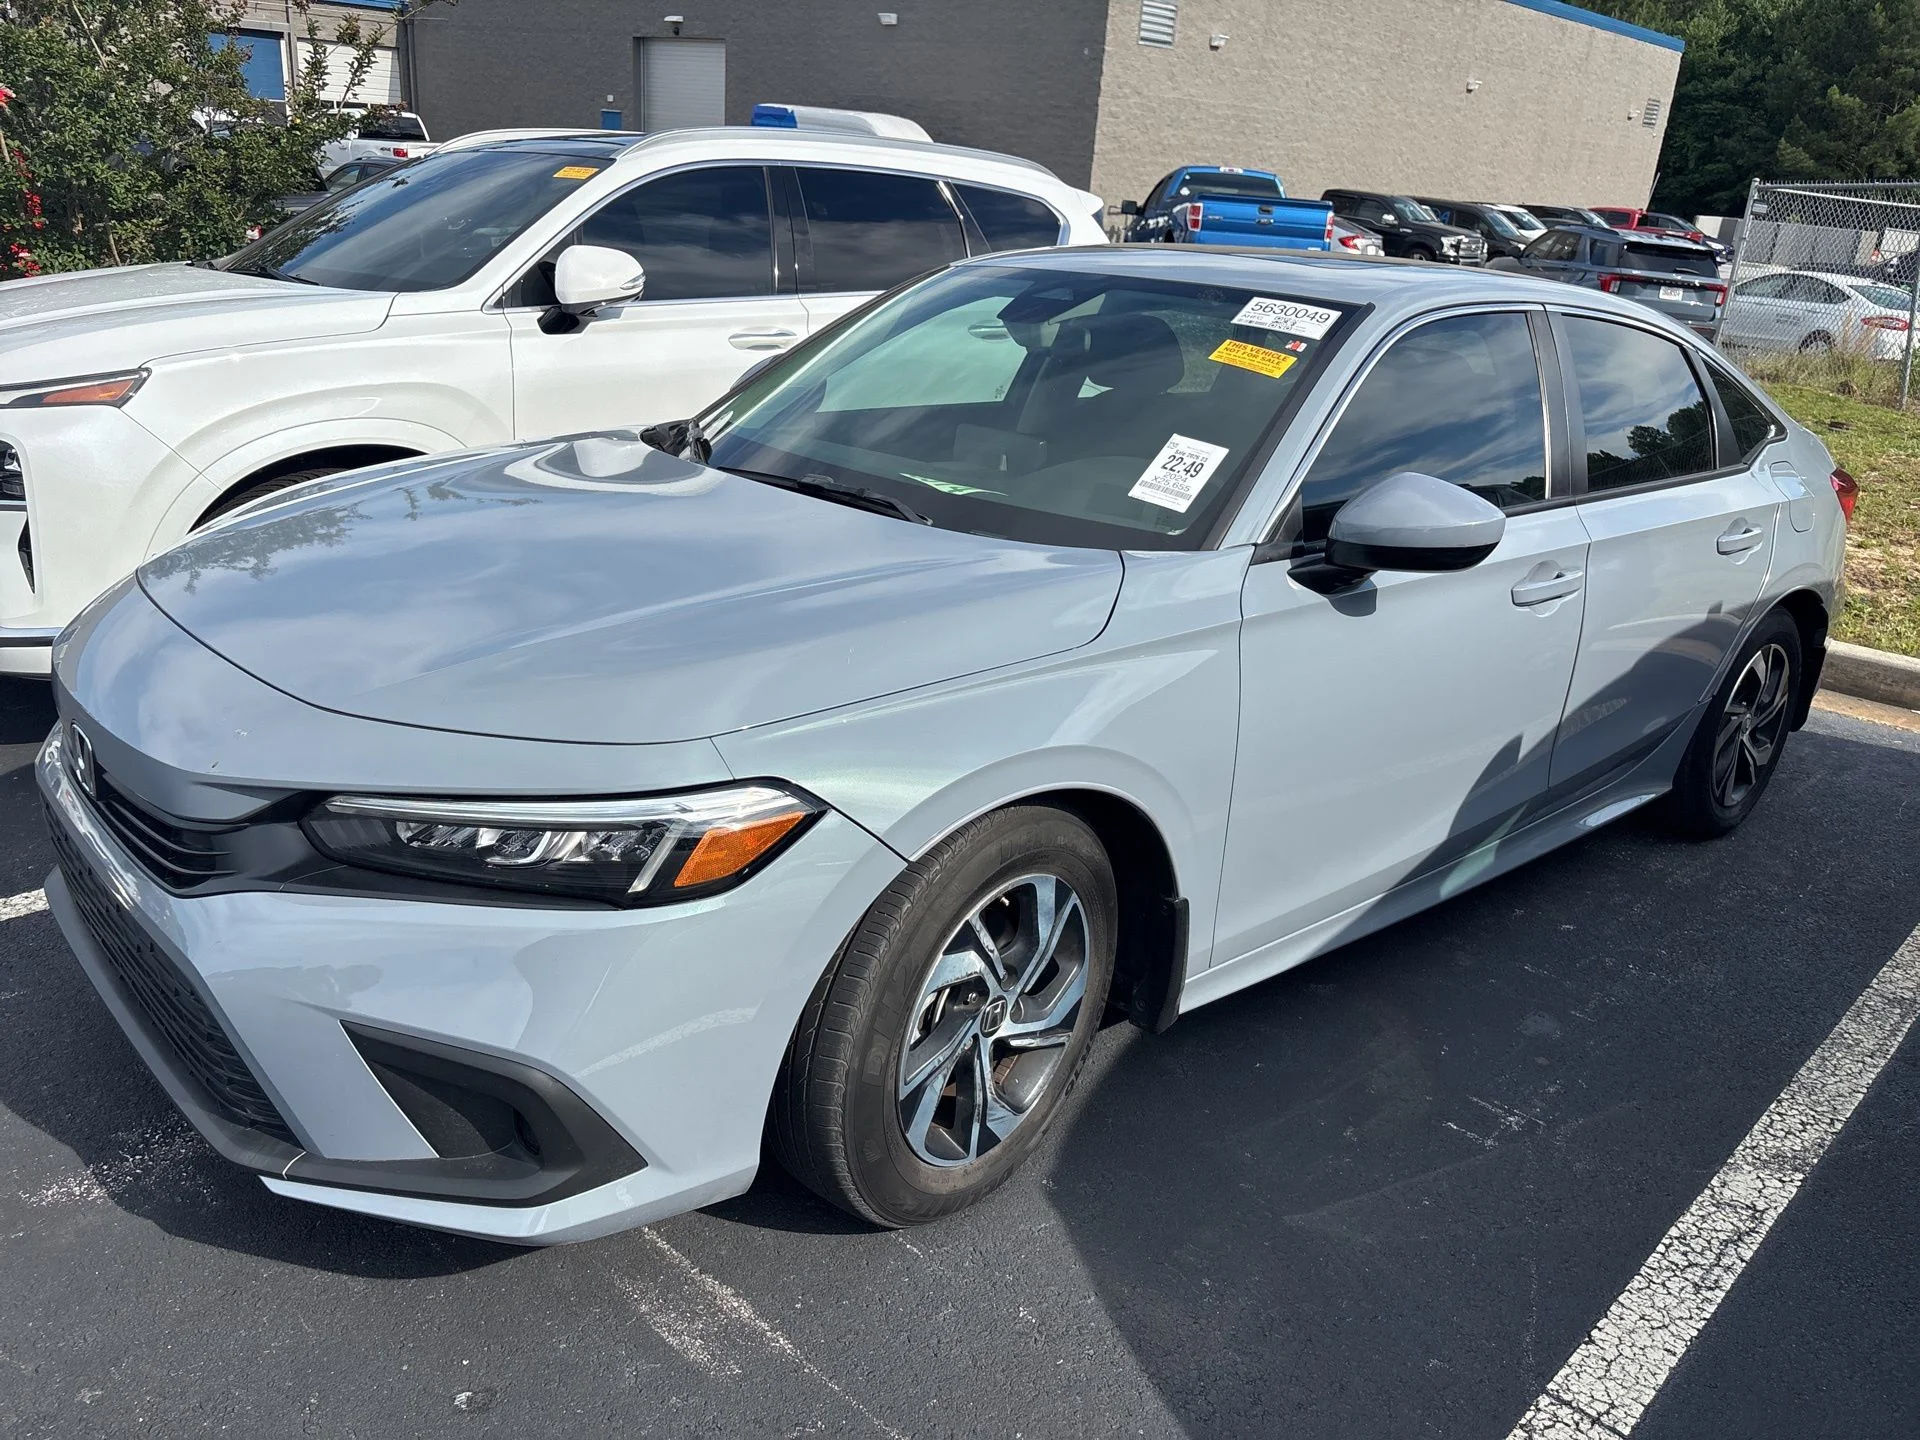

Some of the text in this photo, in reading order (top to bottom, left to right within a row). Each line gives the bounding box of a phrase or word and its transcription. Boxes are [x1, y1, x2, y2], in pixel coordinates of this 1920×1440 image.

[1251, 301, 1331, 324] 5630049
[1226, 341, 1248, 351] THIS
[1250, 347, 1290, 362] VEHICLE
[1241, 351, 1260, 359] FOR
[1260, 356, 1283, 366] SALE
[1161, 454, 1205, 478] 22:49
[1163, 471, 1188, 483] 2024
